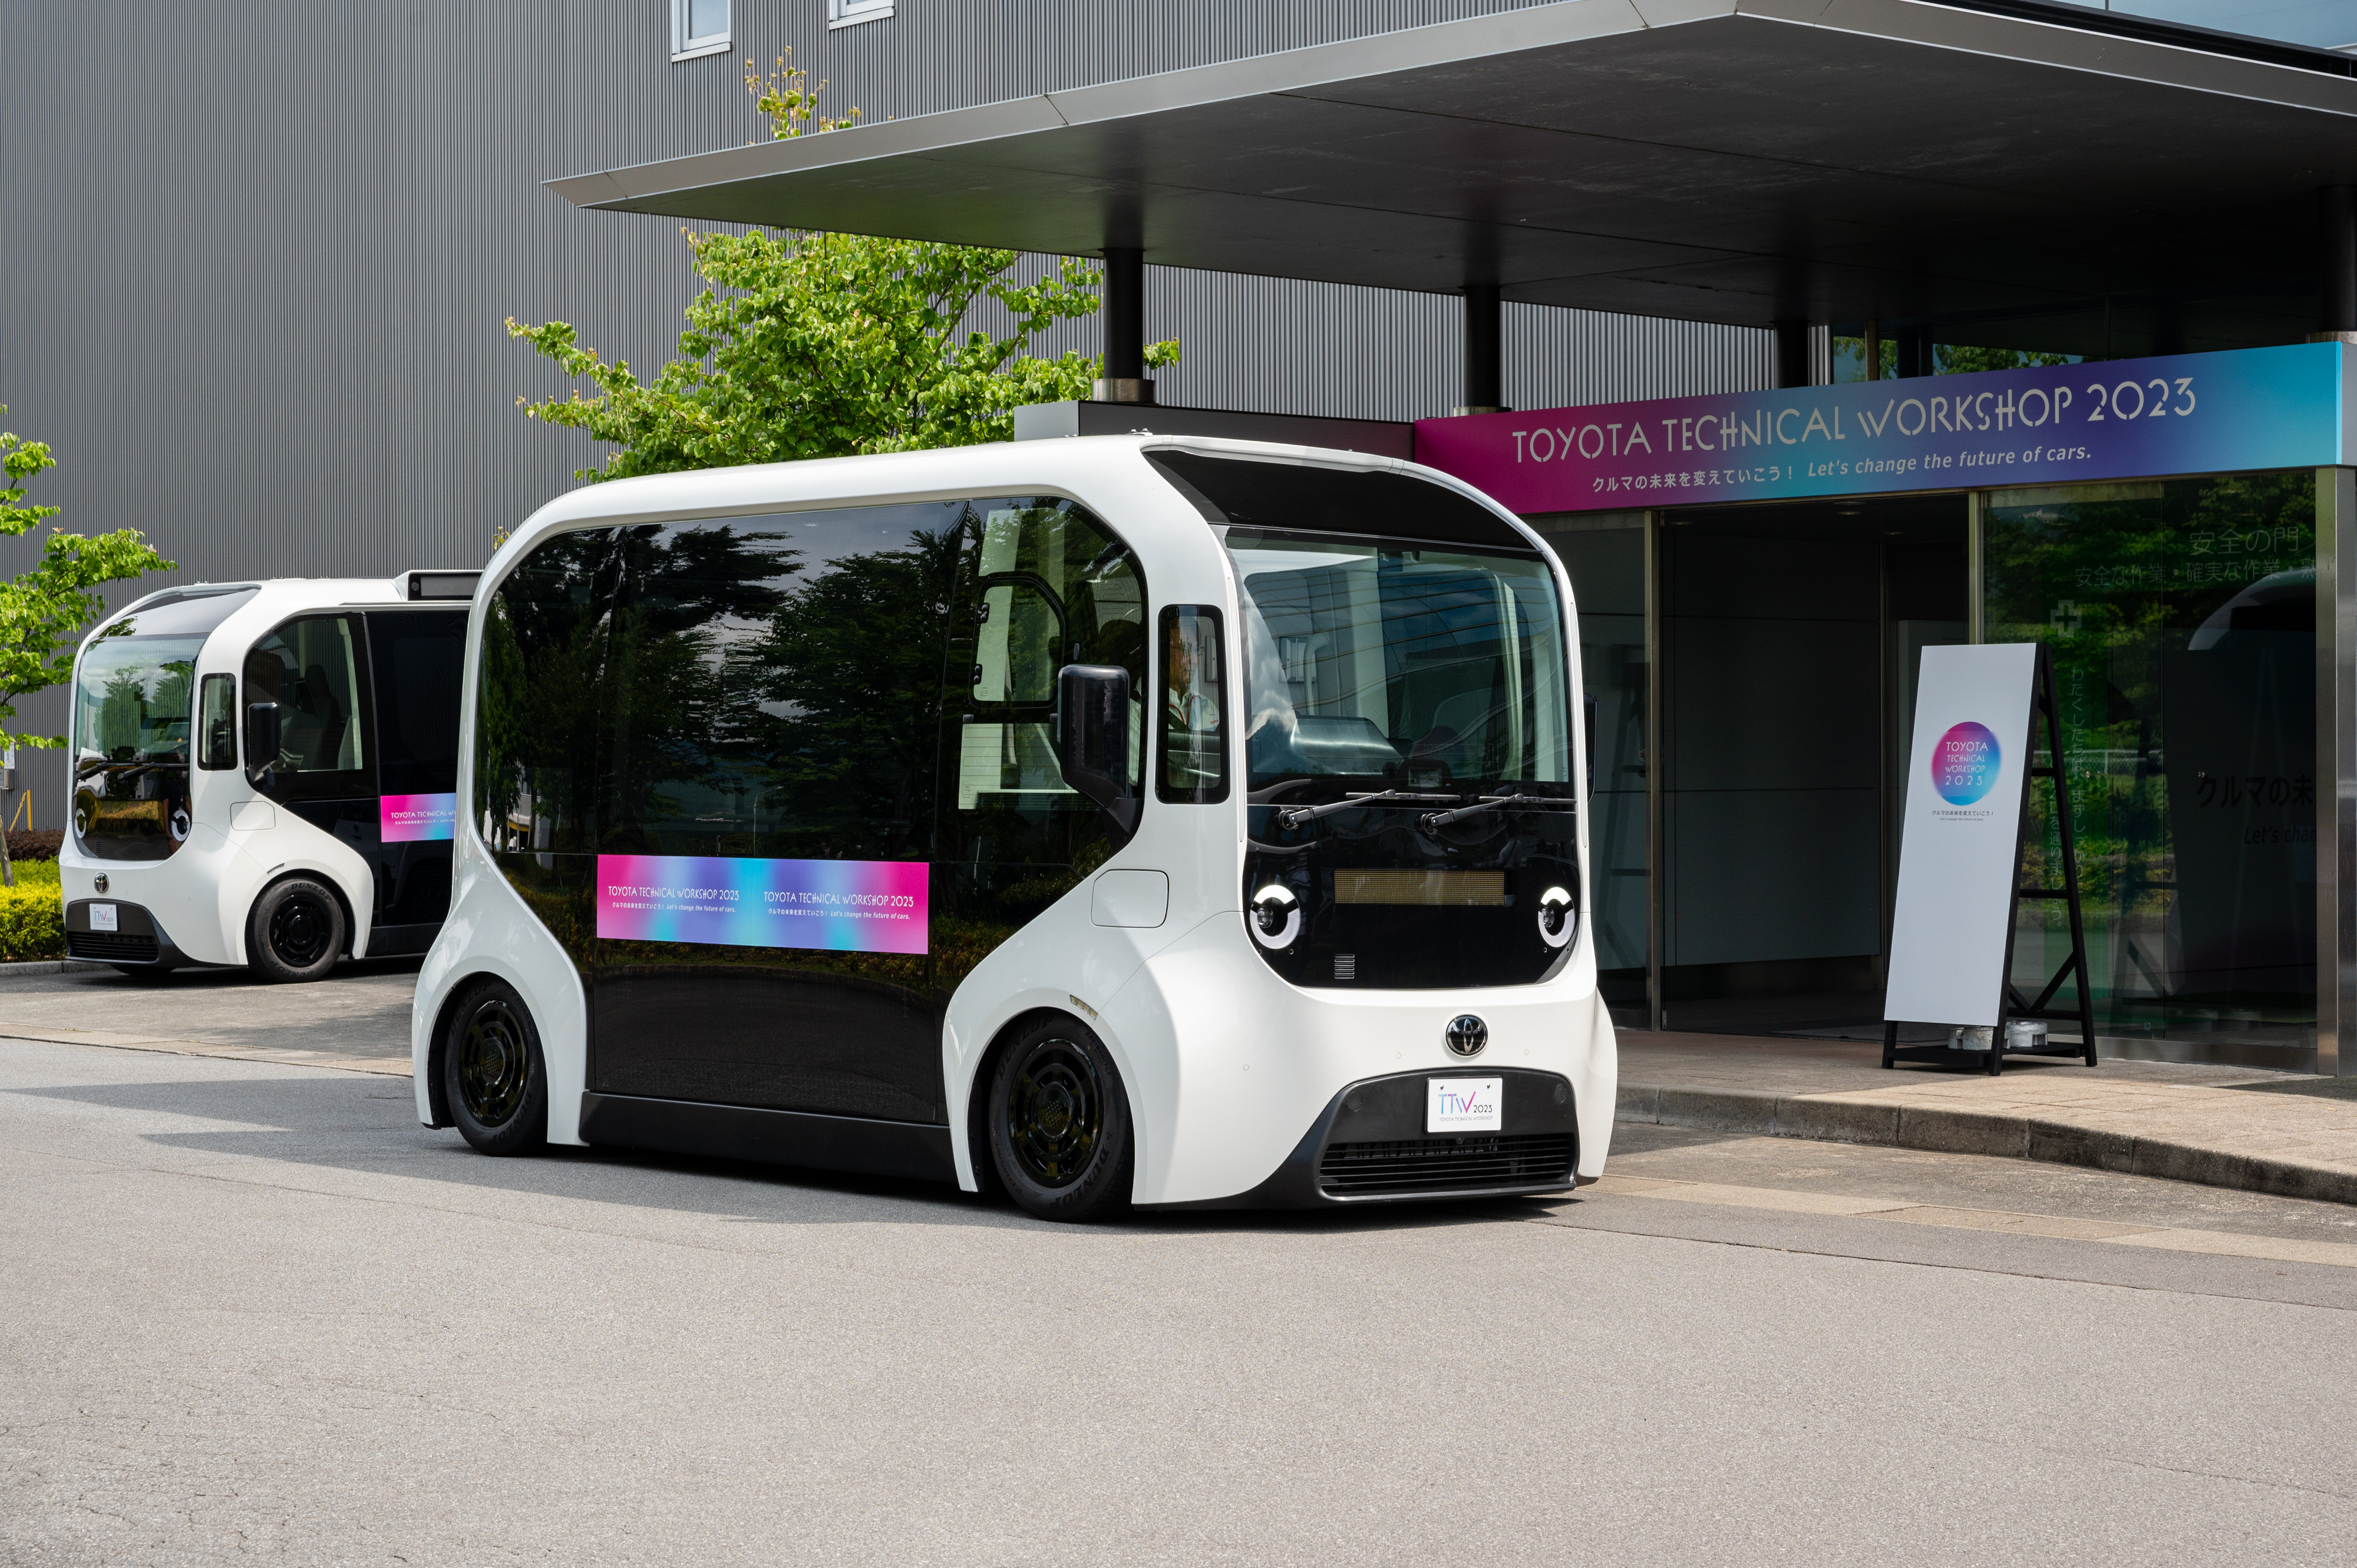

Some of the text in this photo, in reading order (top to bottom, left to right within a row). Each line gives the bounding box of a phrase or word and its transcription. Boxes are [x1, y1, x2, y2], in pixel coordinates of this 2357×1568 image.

[1513, 377, 2196, 463] TOYOTA TECHNICAL WORKSHOP 2023
[1808, 445, 2091, 477] Let's change the future of cars.
[1593, 466, 1792, 493] クルマの未来を変えていこう！
[2190, 526, 2299, 556] 安全の門
[1946, 741, 1988, 752] TOYOTA
[1947, 754, 1985, 762] TECHNICAL
[1945, 765, 1985, 773] WORKSHOP
[1945, 775, 1982, 785] 2023
[291, 883, 332, 902] DUNLOP
[608, 886, 739, 901] TOYOTA TECHNICAL WORKSHOP 2023
[764, 892, 913, 907] TOYOTA TECHNICAL WORKSHOP 2023
[1438, 1091, 1493, 1114] TTW 2023
[1050, 1144, 1109, 1209] DUNLOP
